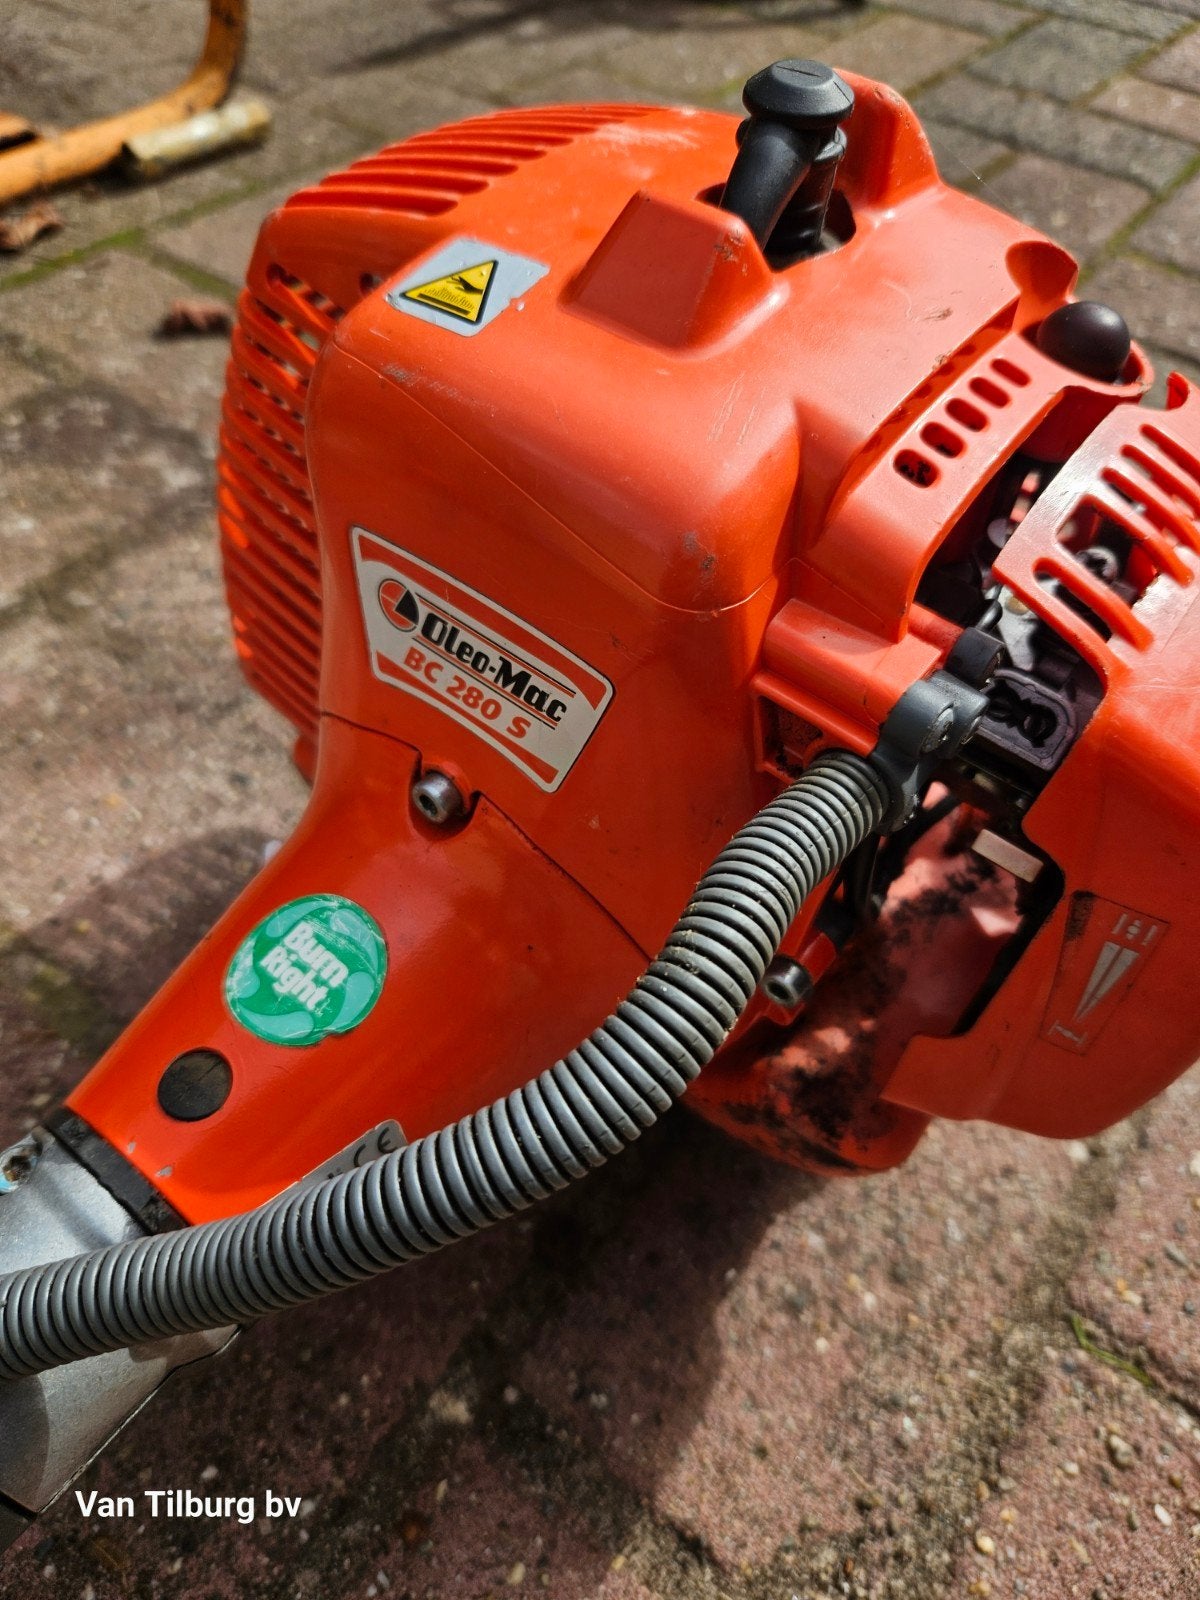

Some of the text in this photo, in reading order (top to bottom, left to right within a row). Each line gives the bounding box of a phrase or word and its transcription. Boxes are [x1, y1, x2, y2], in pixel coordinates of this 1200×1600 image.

[403, 646, 532, 739] BC 280 S
[421, 612, 567, 722] Oleo-Mac
[259, 945, 329, 1011] Right
[283, 921, 349, 988] Burn
